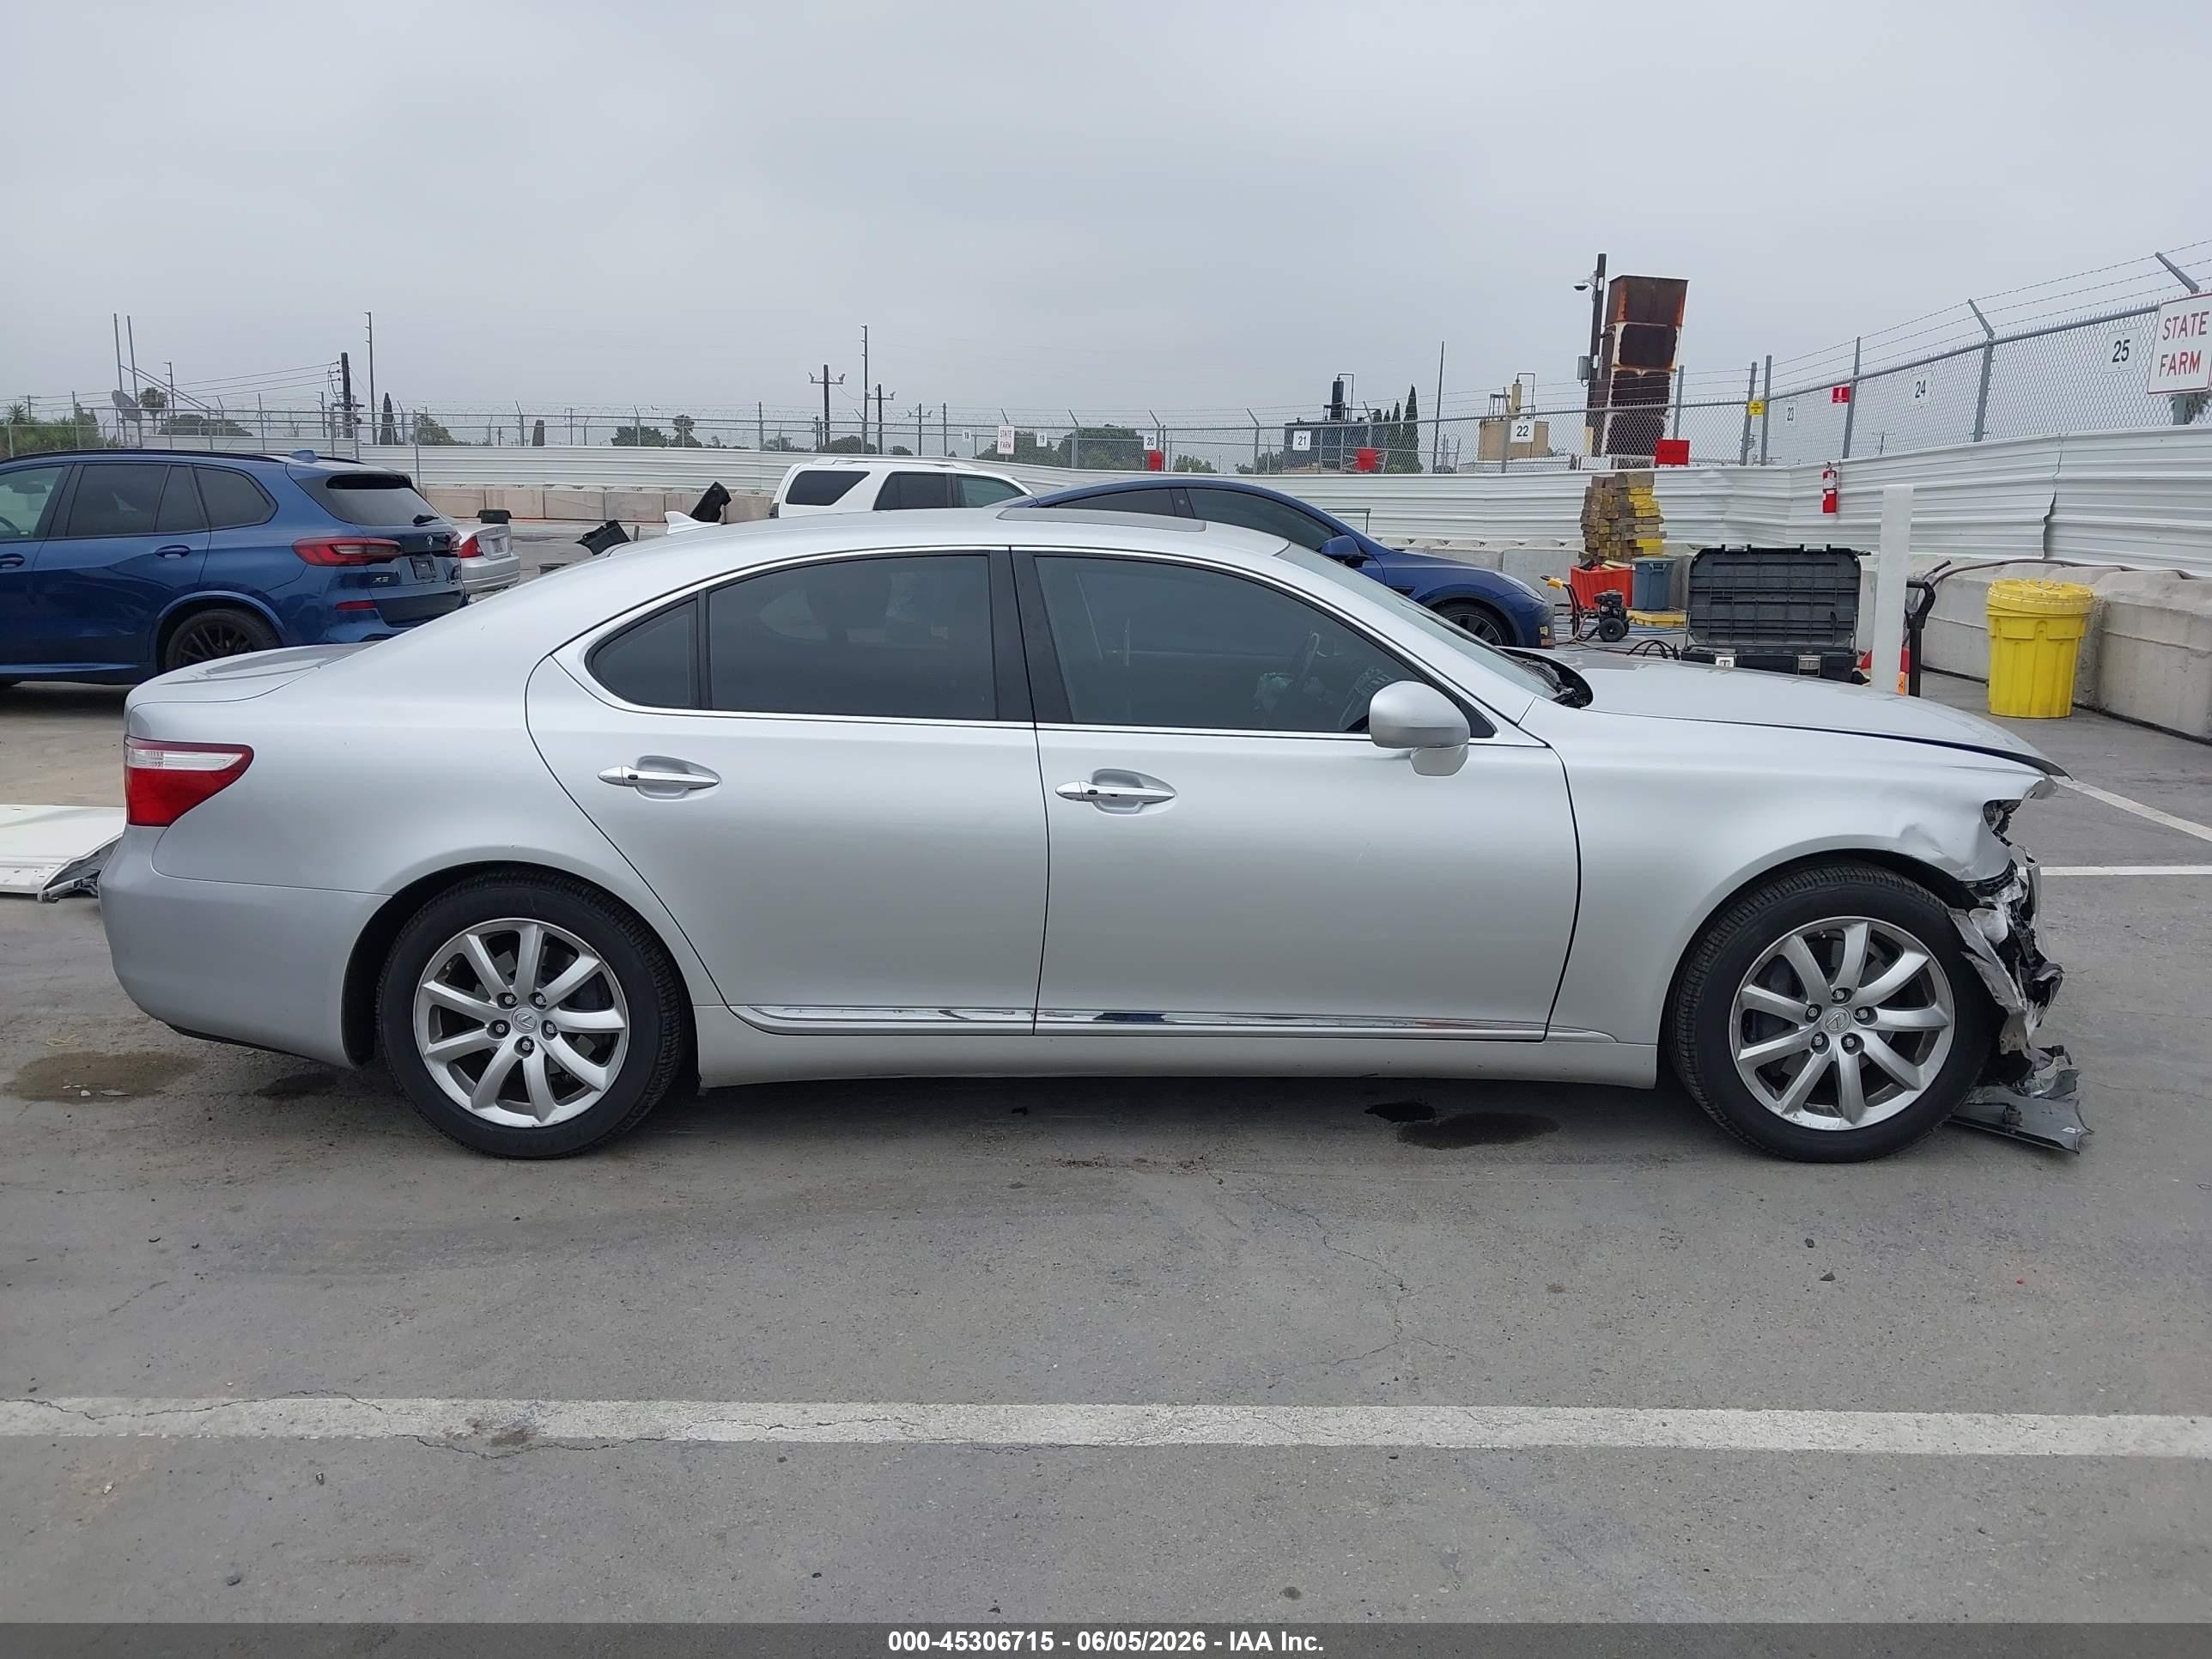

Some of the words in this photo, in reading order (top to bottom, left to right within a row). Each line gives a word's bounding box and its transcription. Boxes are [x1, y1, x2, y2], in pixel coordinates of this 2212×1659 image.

[2162, 311, 2209, 341] STATE
[2112, 339, 2130, 362] 25
[2159, 350, 2202, 378] FARM
[1915, 380, 1926, 398] 24
[1787, 407, 1794, 422] 23
[1516, 425, 1528, 437] 22
[1146, 437, 1155, 446] 20
[1297, 435, 1307, 447] 21
